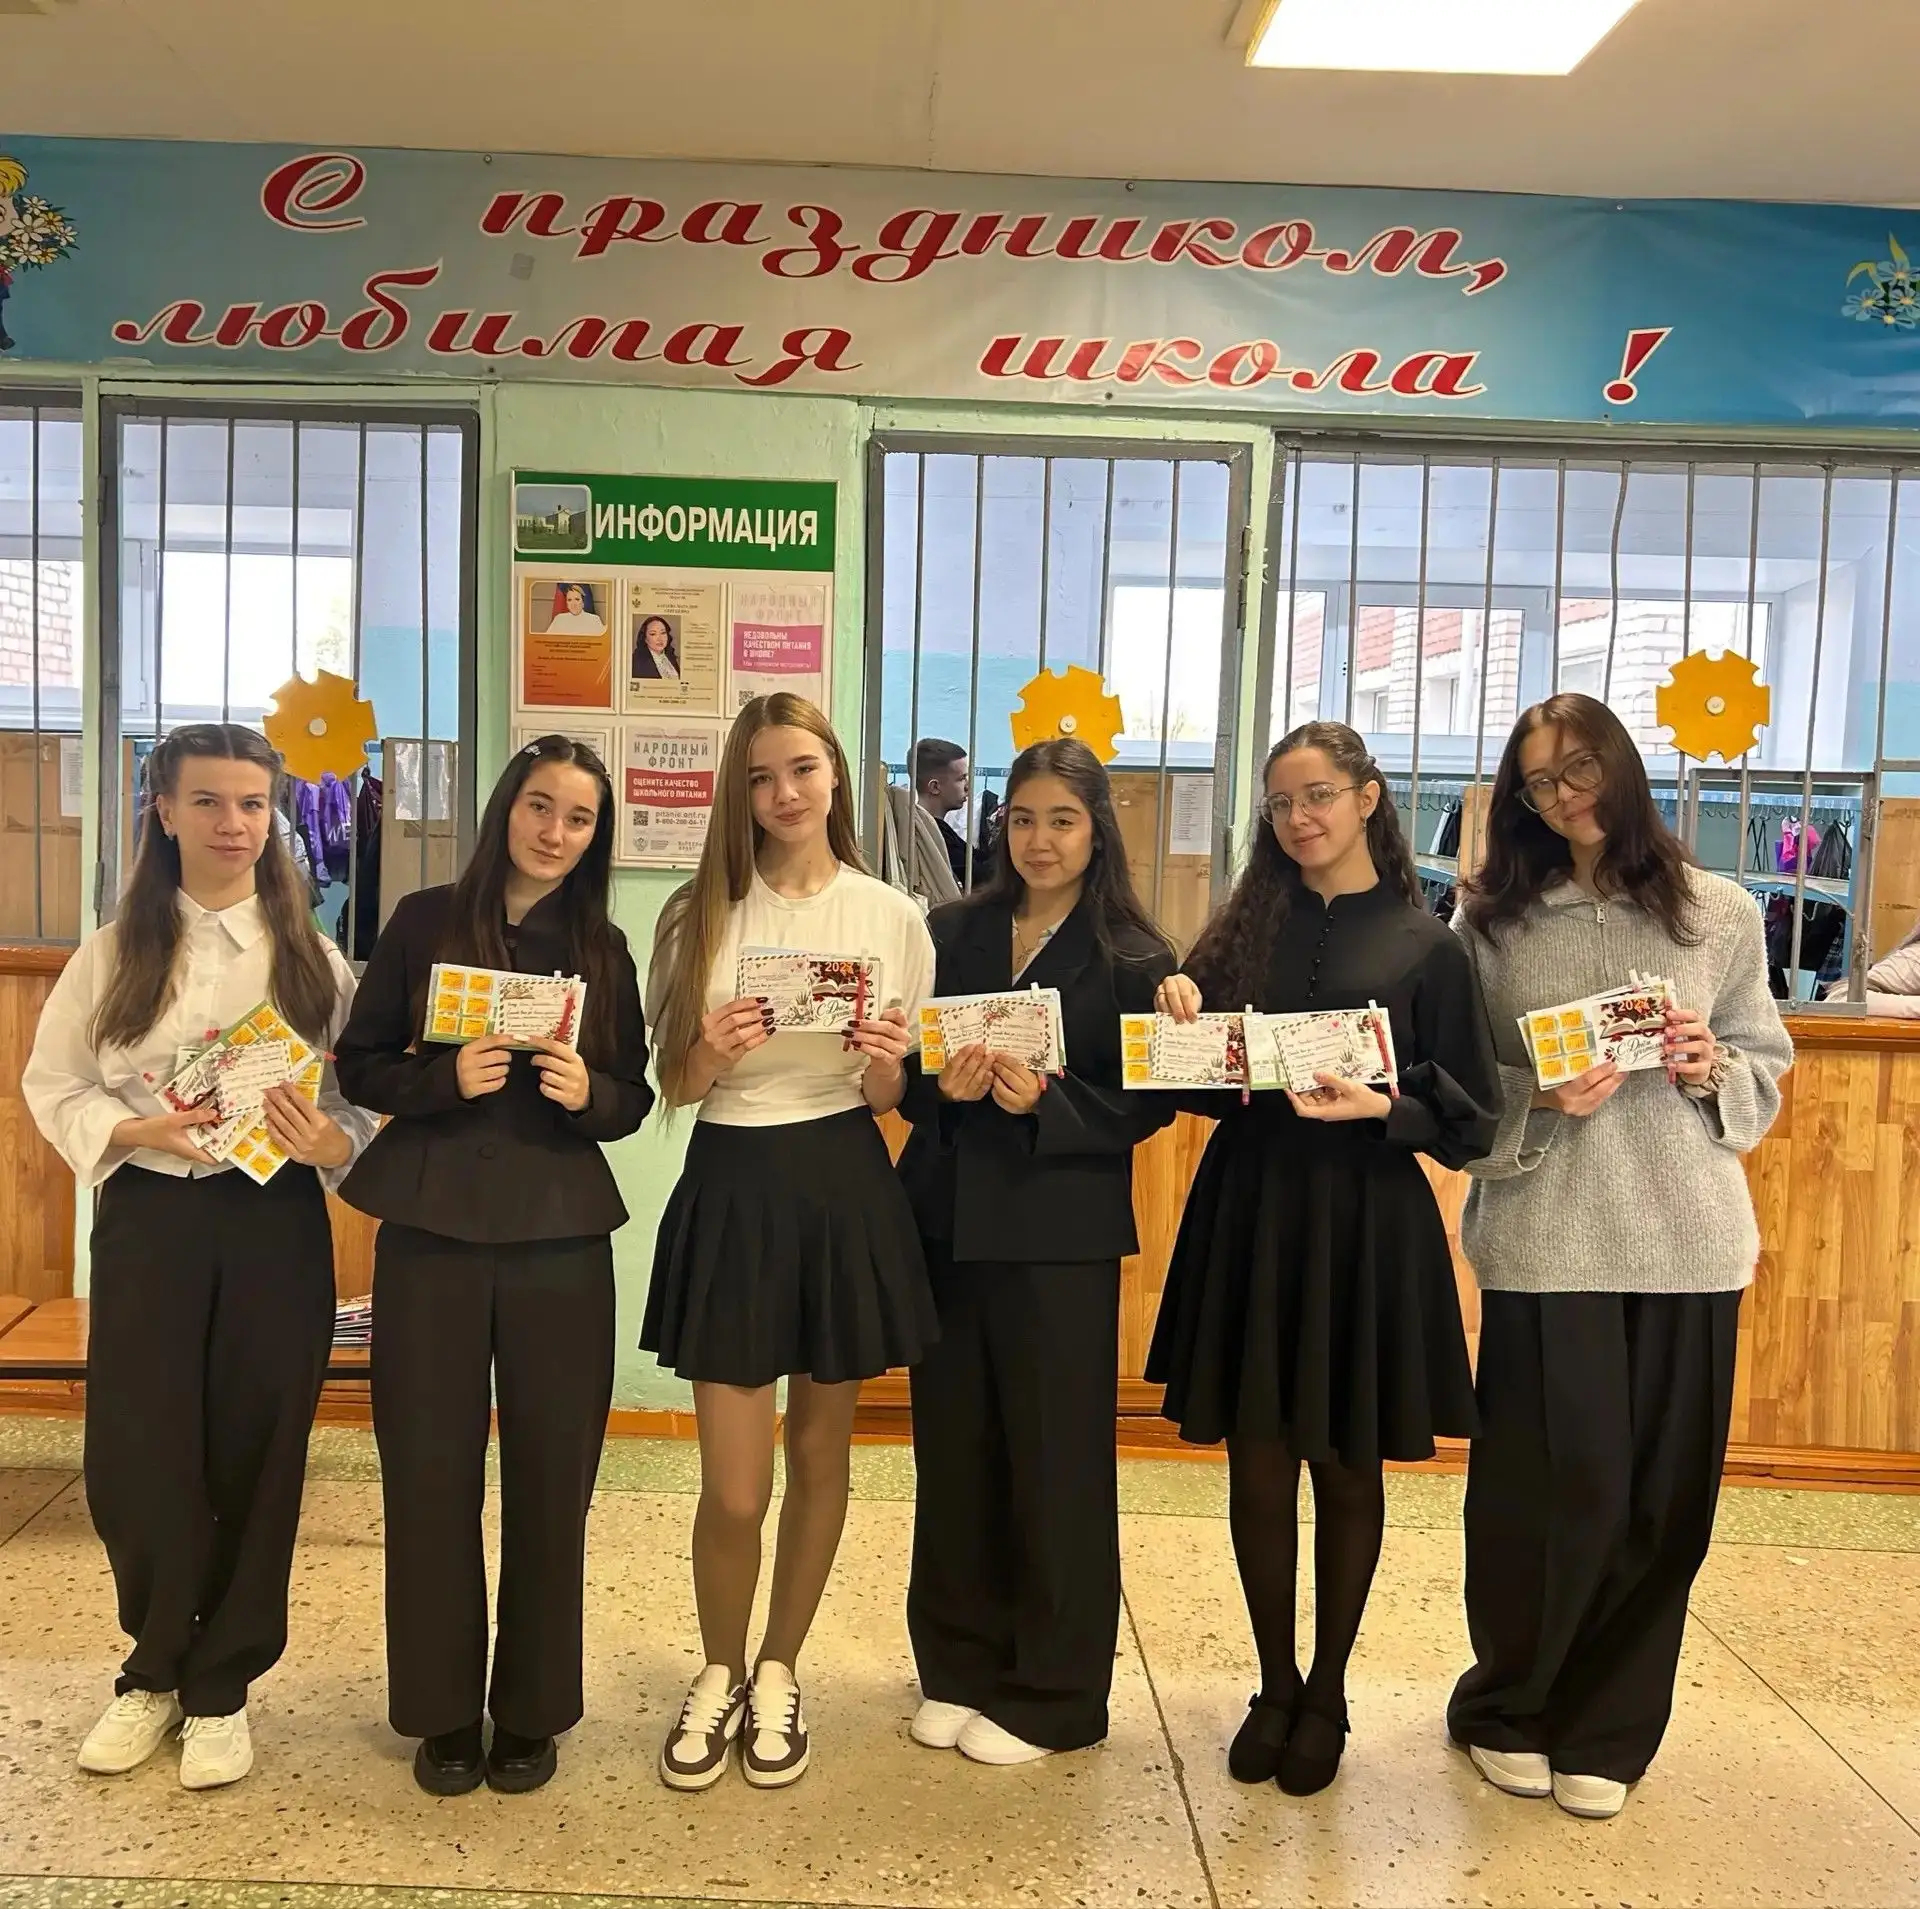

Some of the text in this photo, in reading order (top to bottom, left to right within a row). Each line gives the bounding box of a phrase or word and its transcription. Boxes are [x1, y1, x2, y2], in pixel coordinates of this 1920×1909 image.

[261, 152, 1505, 293] С праздником,
[113, 263, 863, 386] любимая
[979, 335, 1487, 398] школа
[595, 503, 818, 551] ИНФОРМАЦИЯ
[743, 640, 781, 650] КАЧЕСТВОМ
[634, 741, 708, 756] НАРОДНЫЙ
[648, 756, 694, 769] ФРОНТ
[633, 778, 699, 788] ОЦЕНИТЕ КАЧЕСТВО
[633, 788, 707, 799] ШКОЛЬНОГО ПИТАНИЯ
